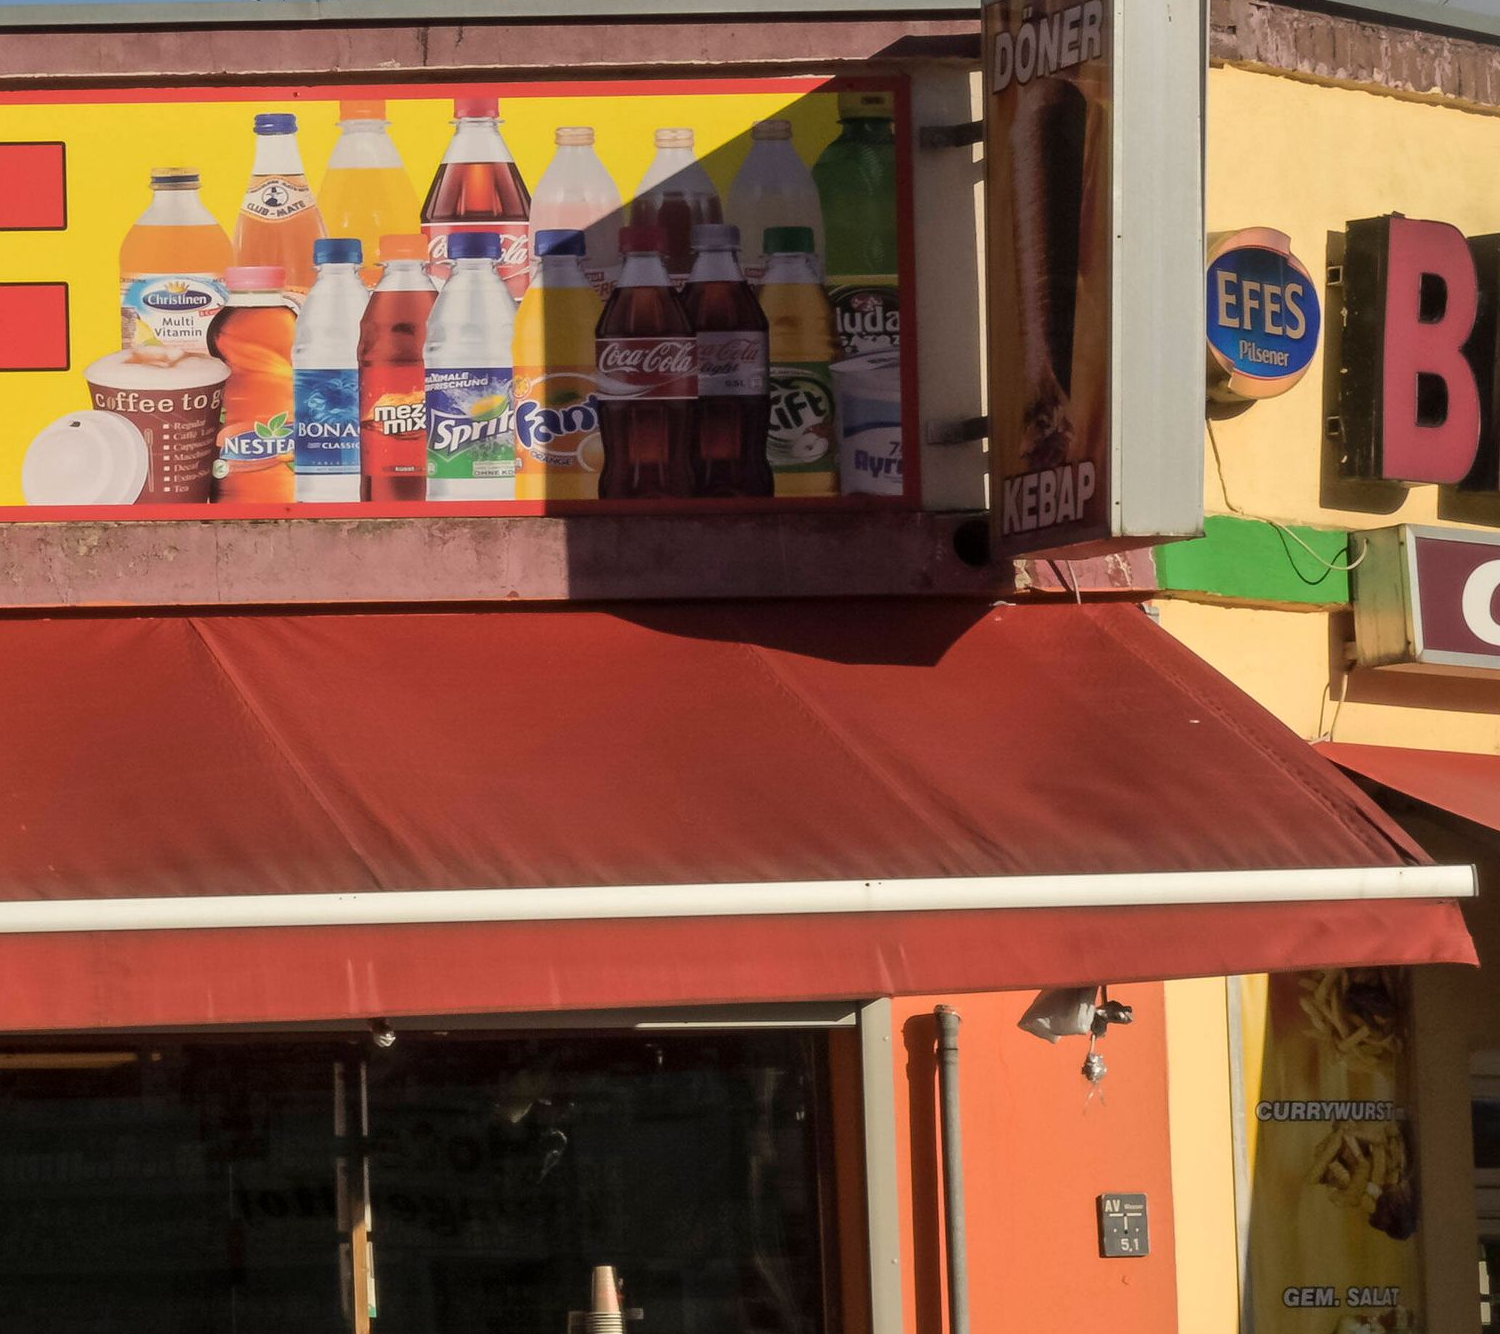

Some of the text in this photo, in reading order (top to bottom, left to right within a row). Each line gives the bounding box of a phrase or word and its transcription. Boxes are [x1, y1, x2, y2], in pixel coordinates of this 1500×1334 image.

[147, 293, 207, 306] Christinen
[1216, 269, 1306, 340] EFES
[162, 317, 194, 327] Multi
[155, 327, 202, 338] Vitamin
[599, 342, 698, 373] Coca-Cola
[1239, 339, 1290, 367] Pilsener
[182, 393, 207, 411] to
[383, 417, 426, 435] mix
[1002, 461, 1095, 536] KEBAP
[1256, 1101, 1394, 1122] CURRYWURST
[1105, 1199, 1120, 1212] AV
[1284, 1285, 1400, 1308] GEM. SALAT
